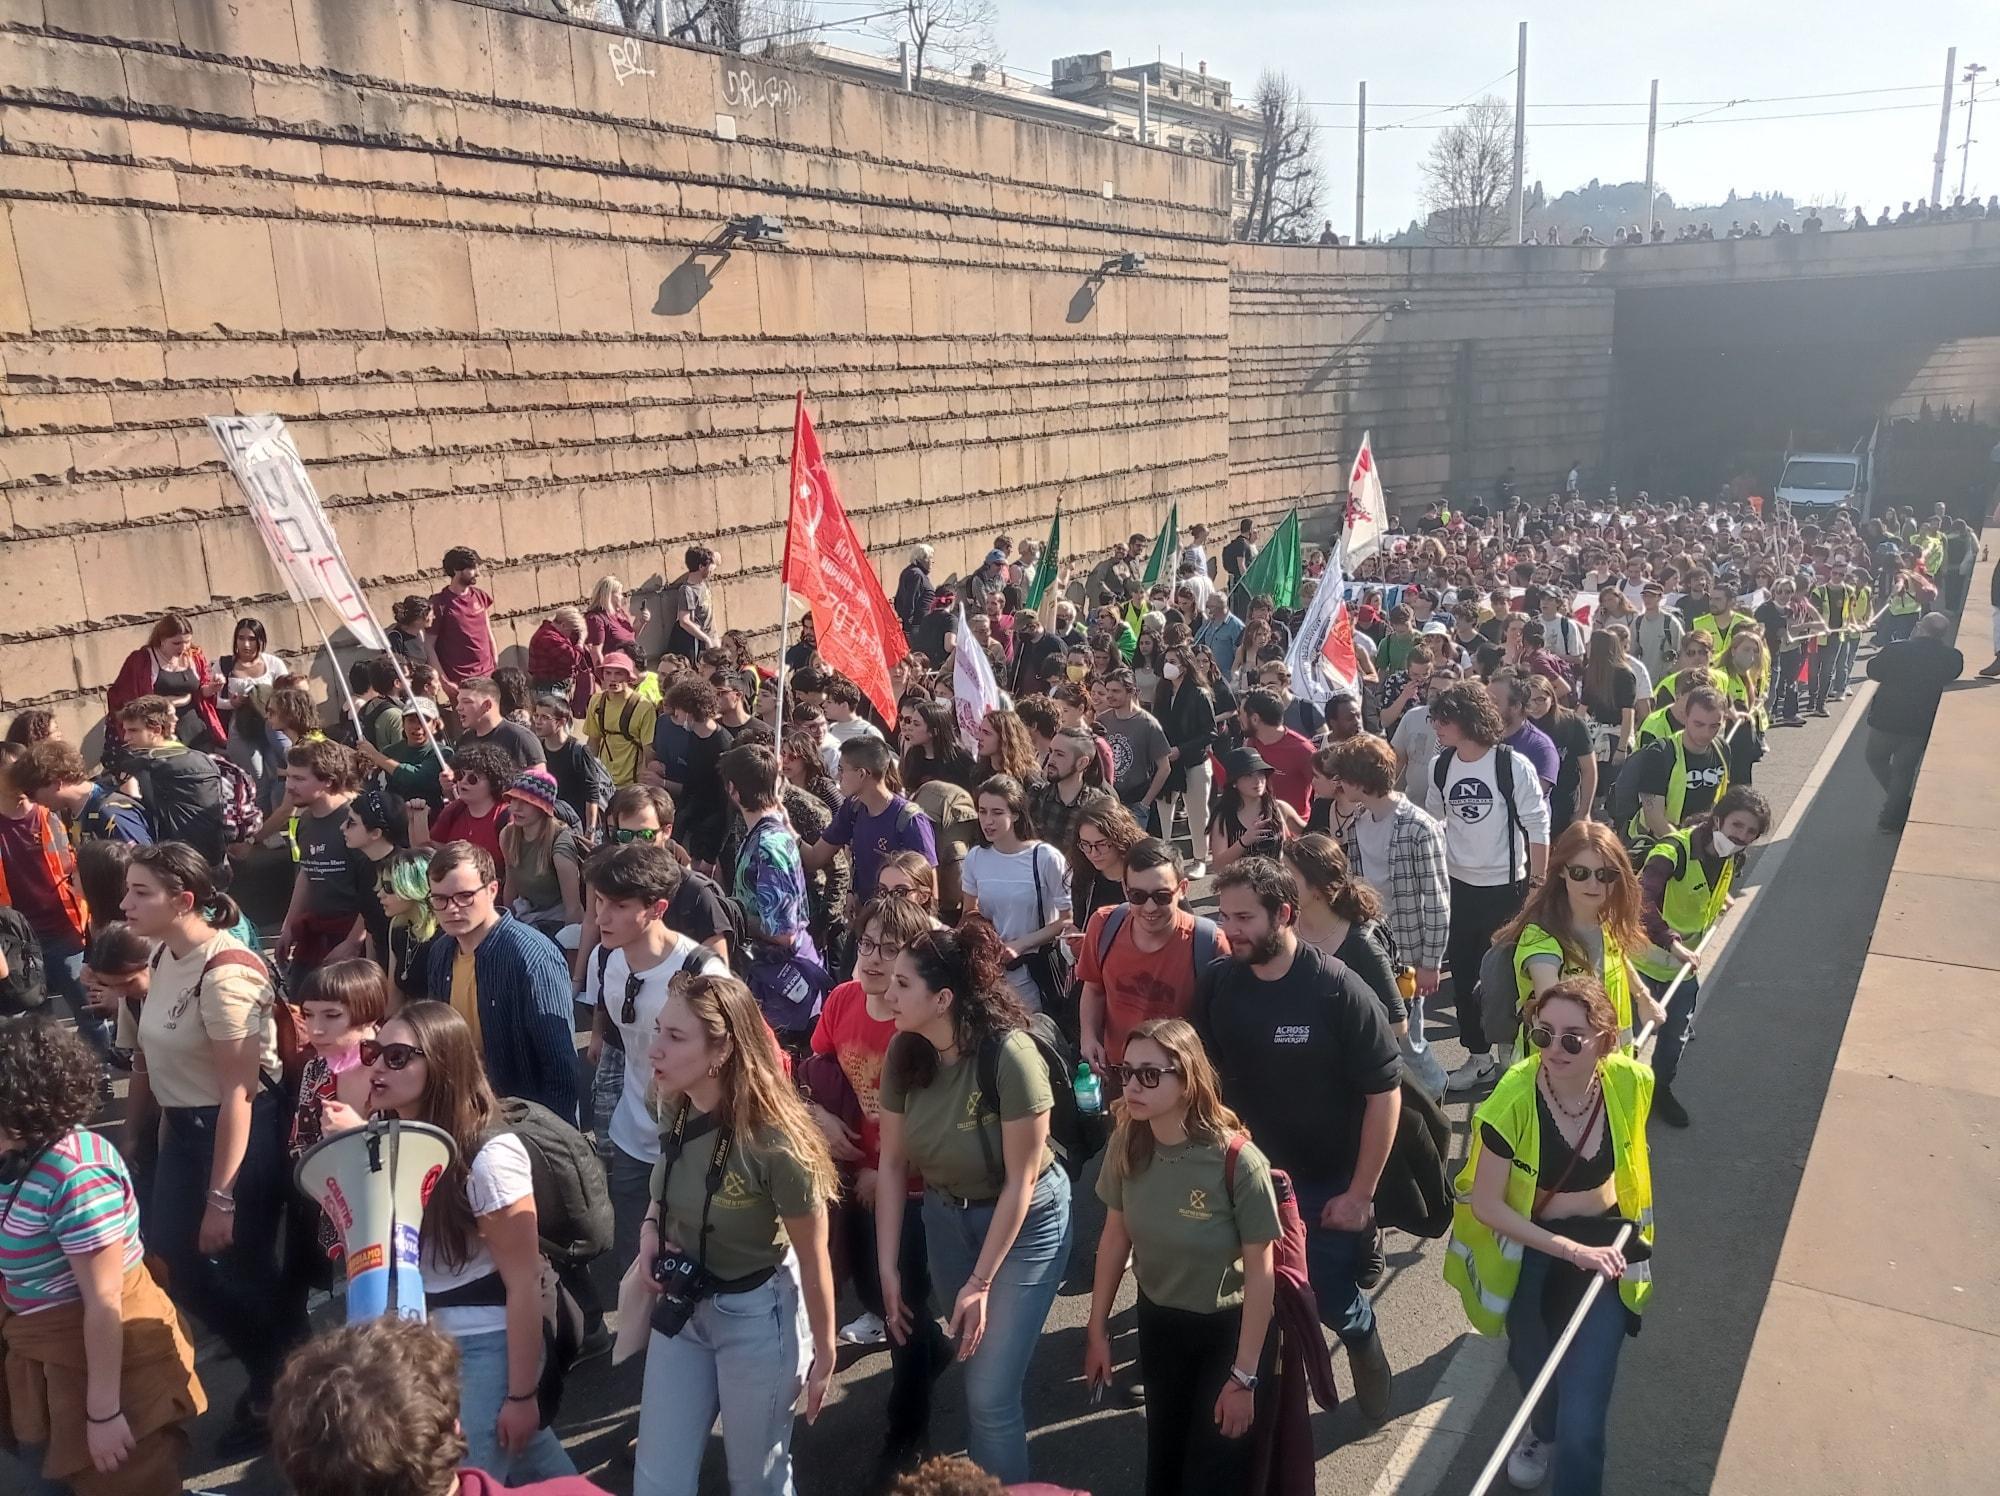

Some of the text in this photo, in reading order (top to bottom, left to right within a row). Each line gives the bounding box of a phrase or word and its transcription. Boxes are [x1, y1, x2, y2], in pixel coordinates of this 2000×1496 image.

[1458, 782, 1481, 797] N
[1461, 805, 1480, 819] S
[1275, 1025, 1310, 1035] ACROSS
[714, 1139, 728, 1167] Nikon
